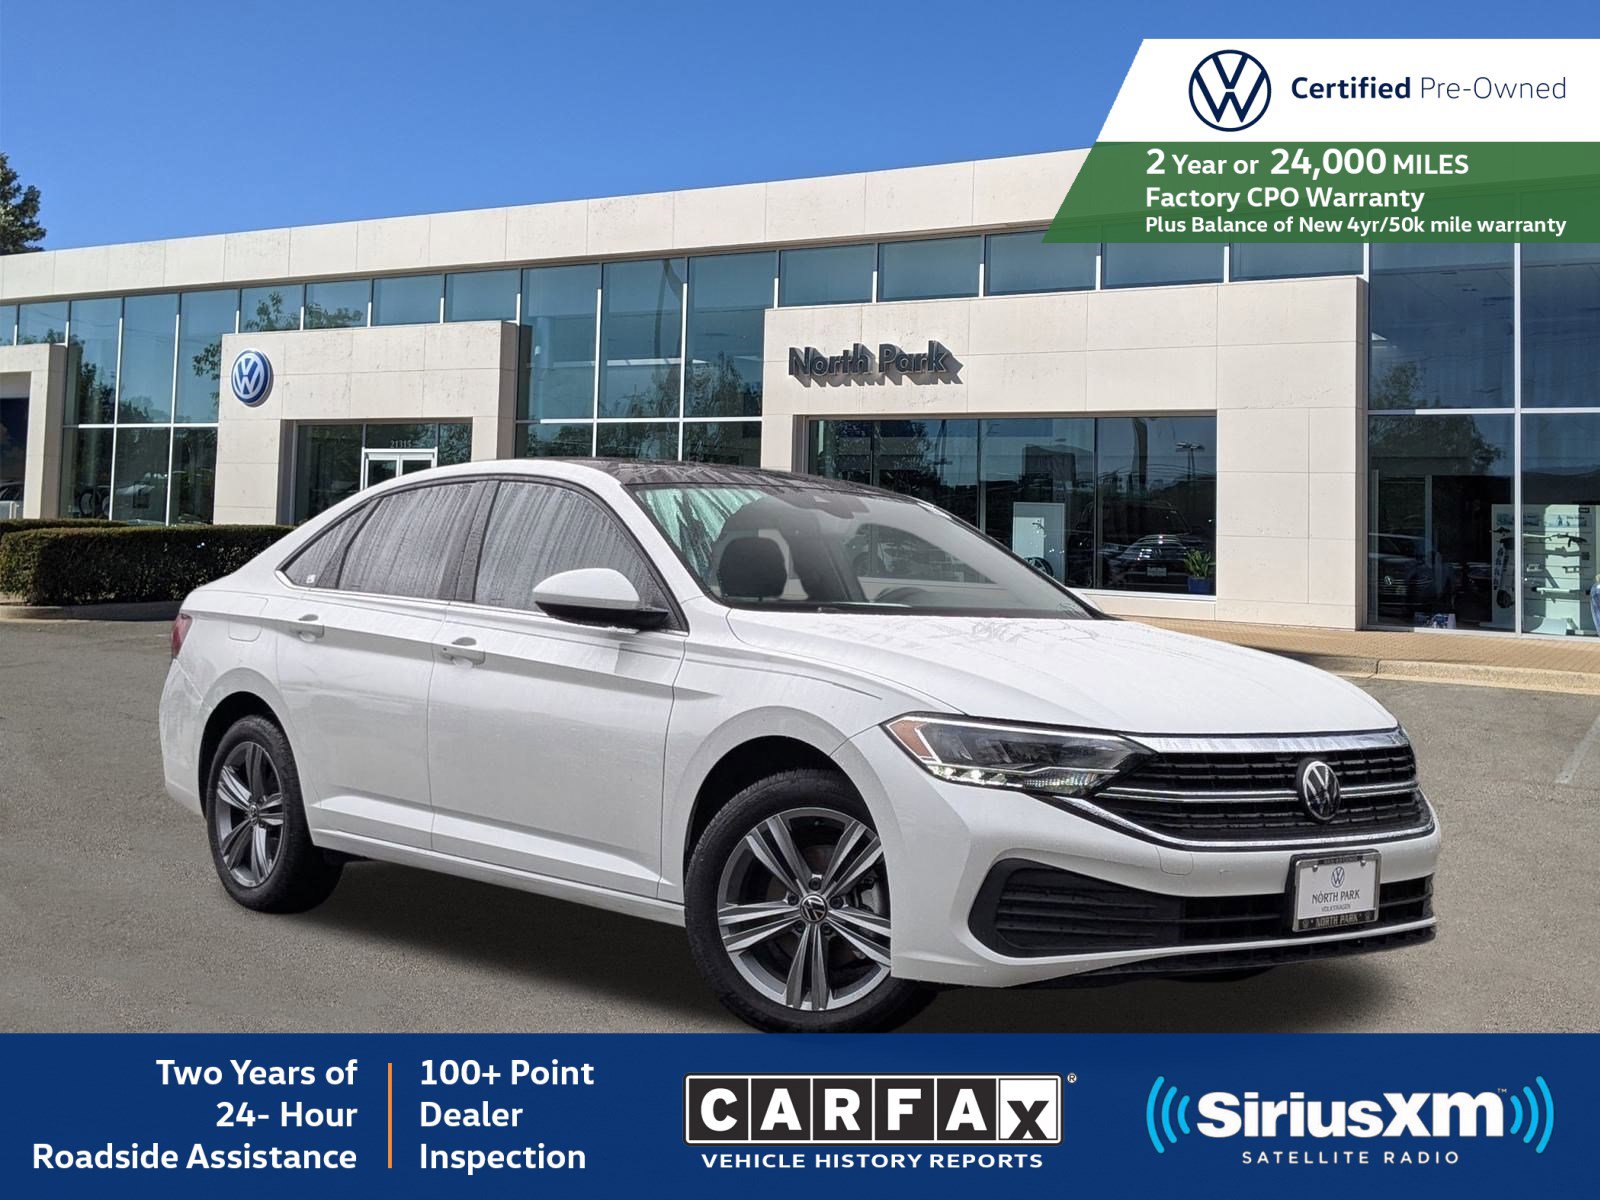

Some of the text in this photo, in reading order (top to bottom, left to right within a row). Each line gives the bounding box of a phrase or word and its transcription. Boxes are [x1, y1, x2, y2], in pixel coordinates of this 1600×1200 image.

[788, 339, 949, 377] North Park
[1312, 889, 1360, 904] NORTH PARK
